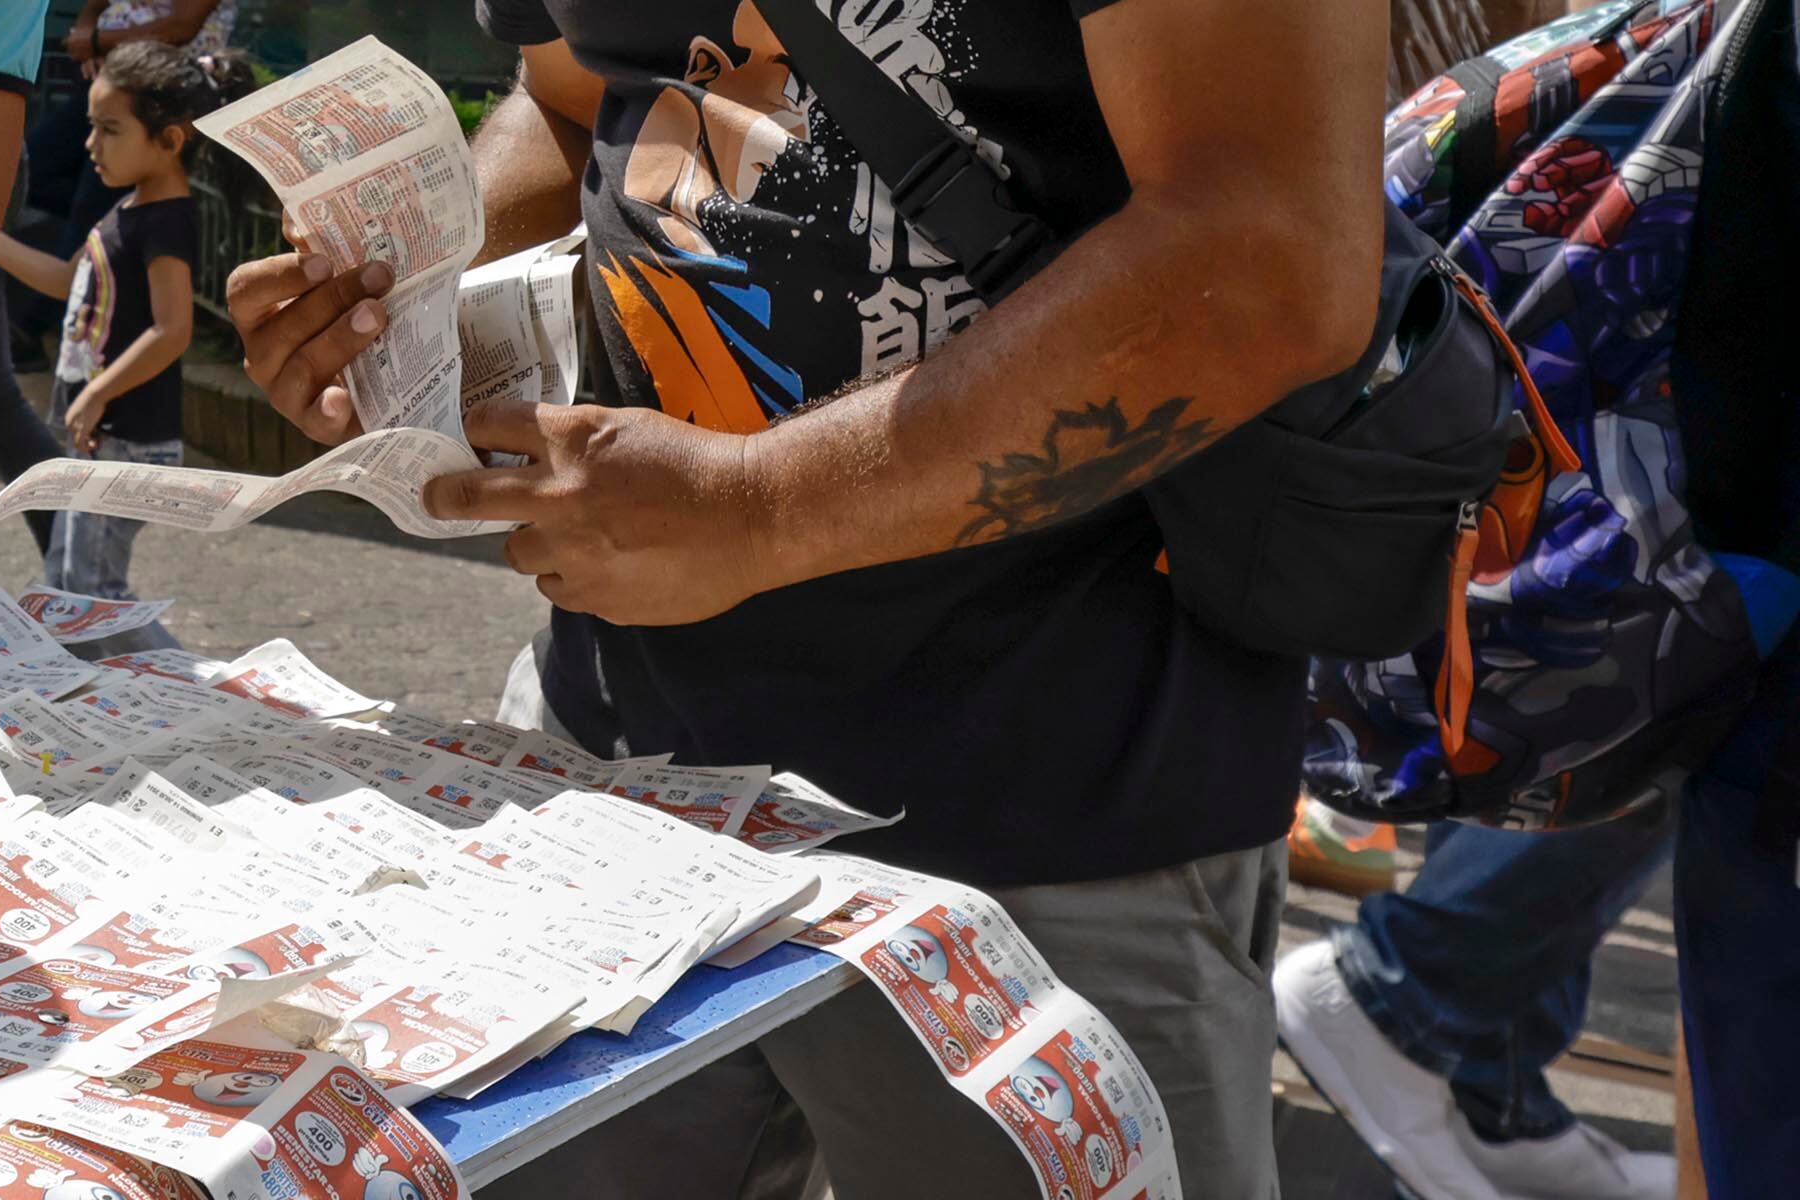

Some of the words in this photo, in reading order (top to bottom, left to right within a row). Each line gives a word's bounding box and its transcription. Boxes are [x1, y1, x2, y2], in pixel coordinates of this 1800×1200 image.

[443, 357, 457, 379] DEL
[410, 377, 442, 407] SORTEO
[466, 379, 511, 408] SORTEO
[952, 947, 980, 983] SOCIAL
[1011, 976, 1030, 999] 4807
[974, 1004, 994, 1027] 400
[308, 1125, 334, 1152] 400
[276, 1124, 329, 1186] BIENESTAR
[1093, 1147, 1107, 1173] 400
[260, 1170, 288, 1200] 4807
[268, 1158, 300, 1198] SORTEO
